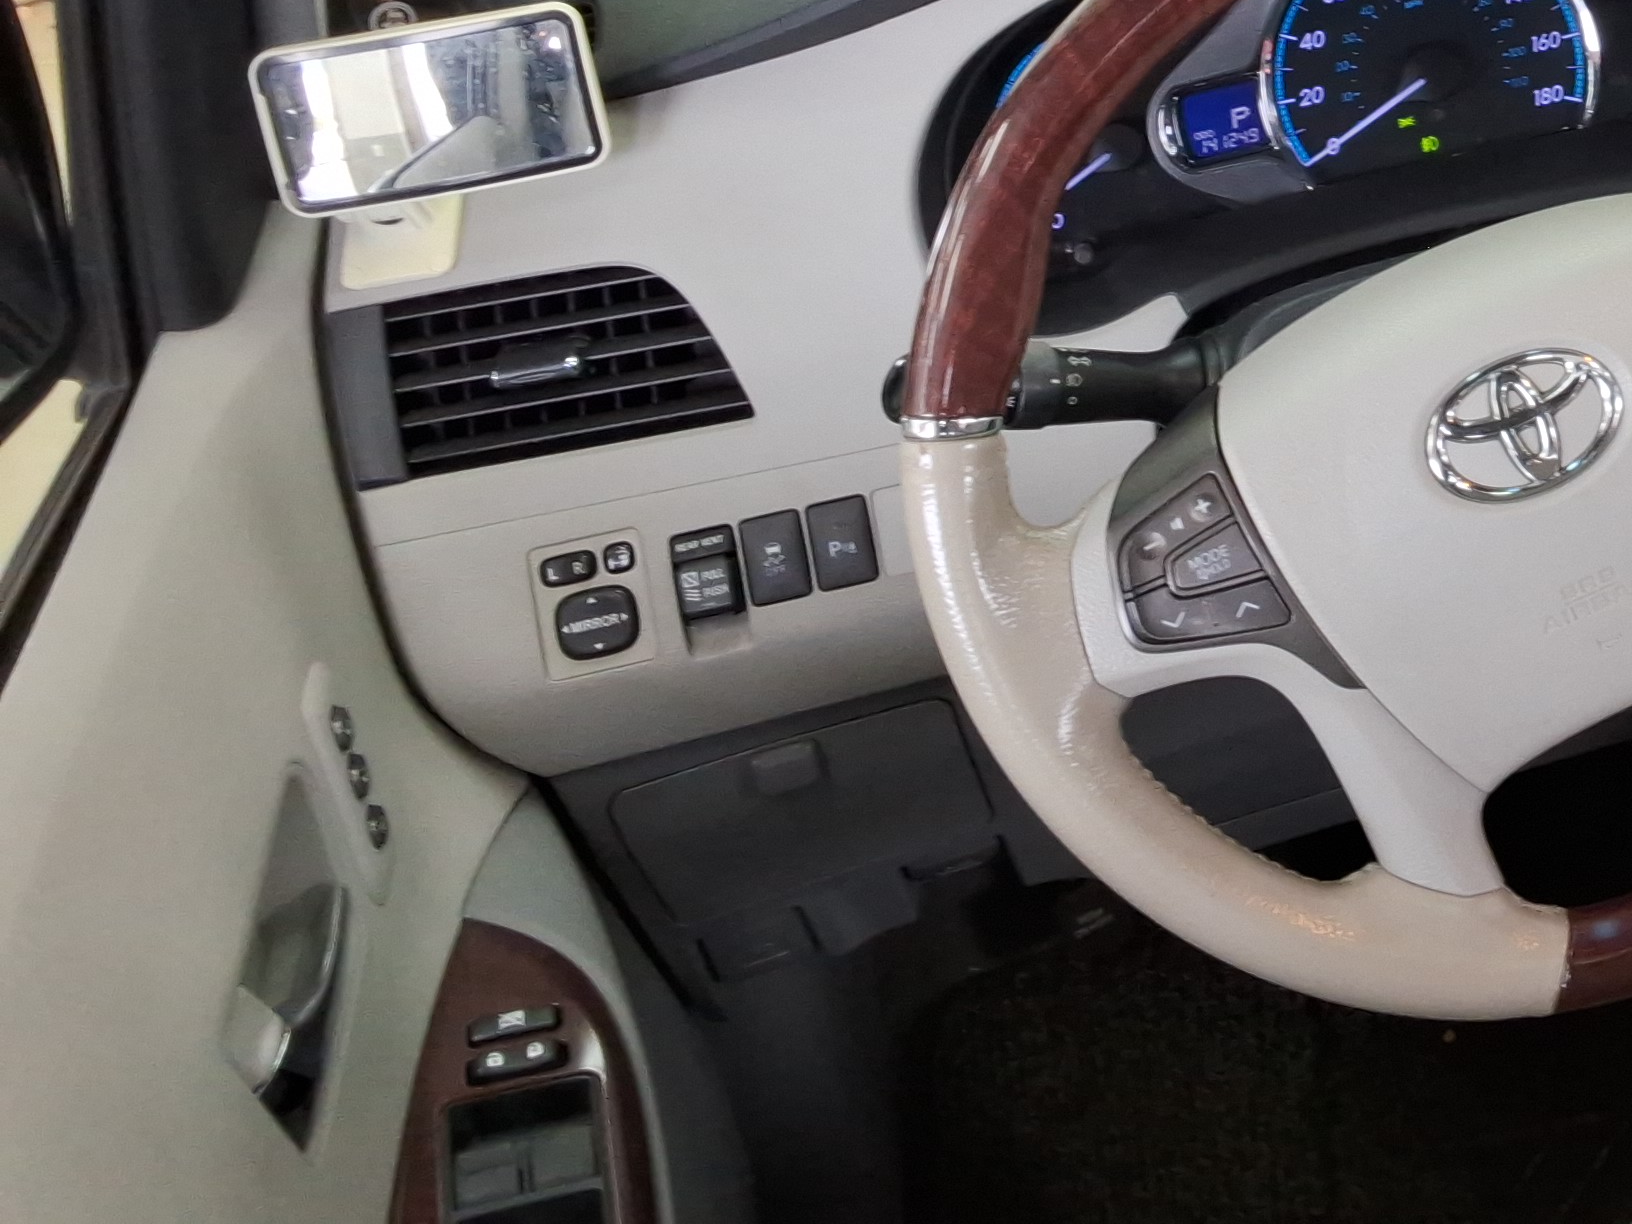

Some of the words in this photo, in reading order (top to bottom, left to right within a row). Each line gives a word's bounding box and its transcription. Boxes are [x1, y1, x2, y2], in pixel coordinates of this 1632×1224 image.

[1299, 30, 1326, 50] 40
[1530, 31, 1561, 53] 160
[1299, 86, 1325, 107] 20
[1533, 84, 1564, 107] 180
[1230, 106, 1251, 129] P
[1187, 544, 1231, 569] MODE
[546, 567, 560, 581] L
[572, 561, 587, 575] R
[568, 613, 620, 634] MIRROR
